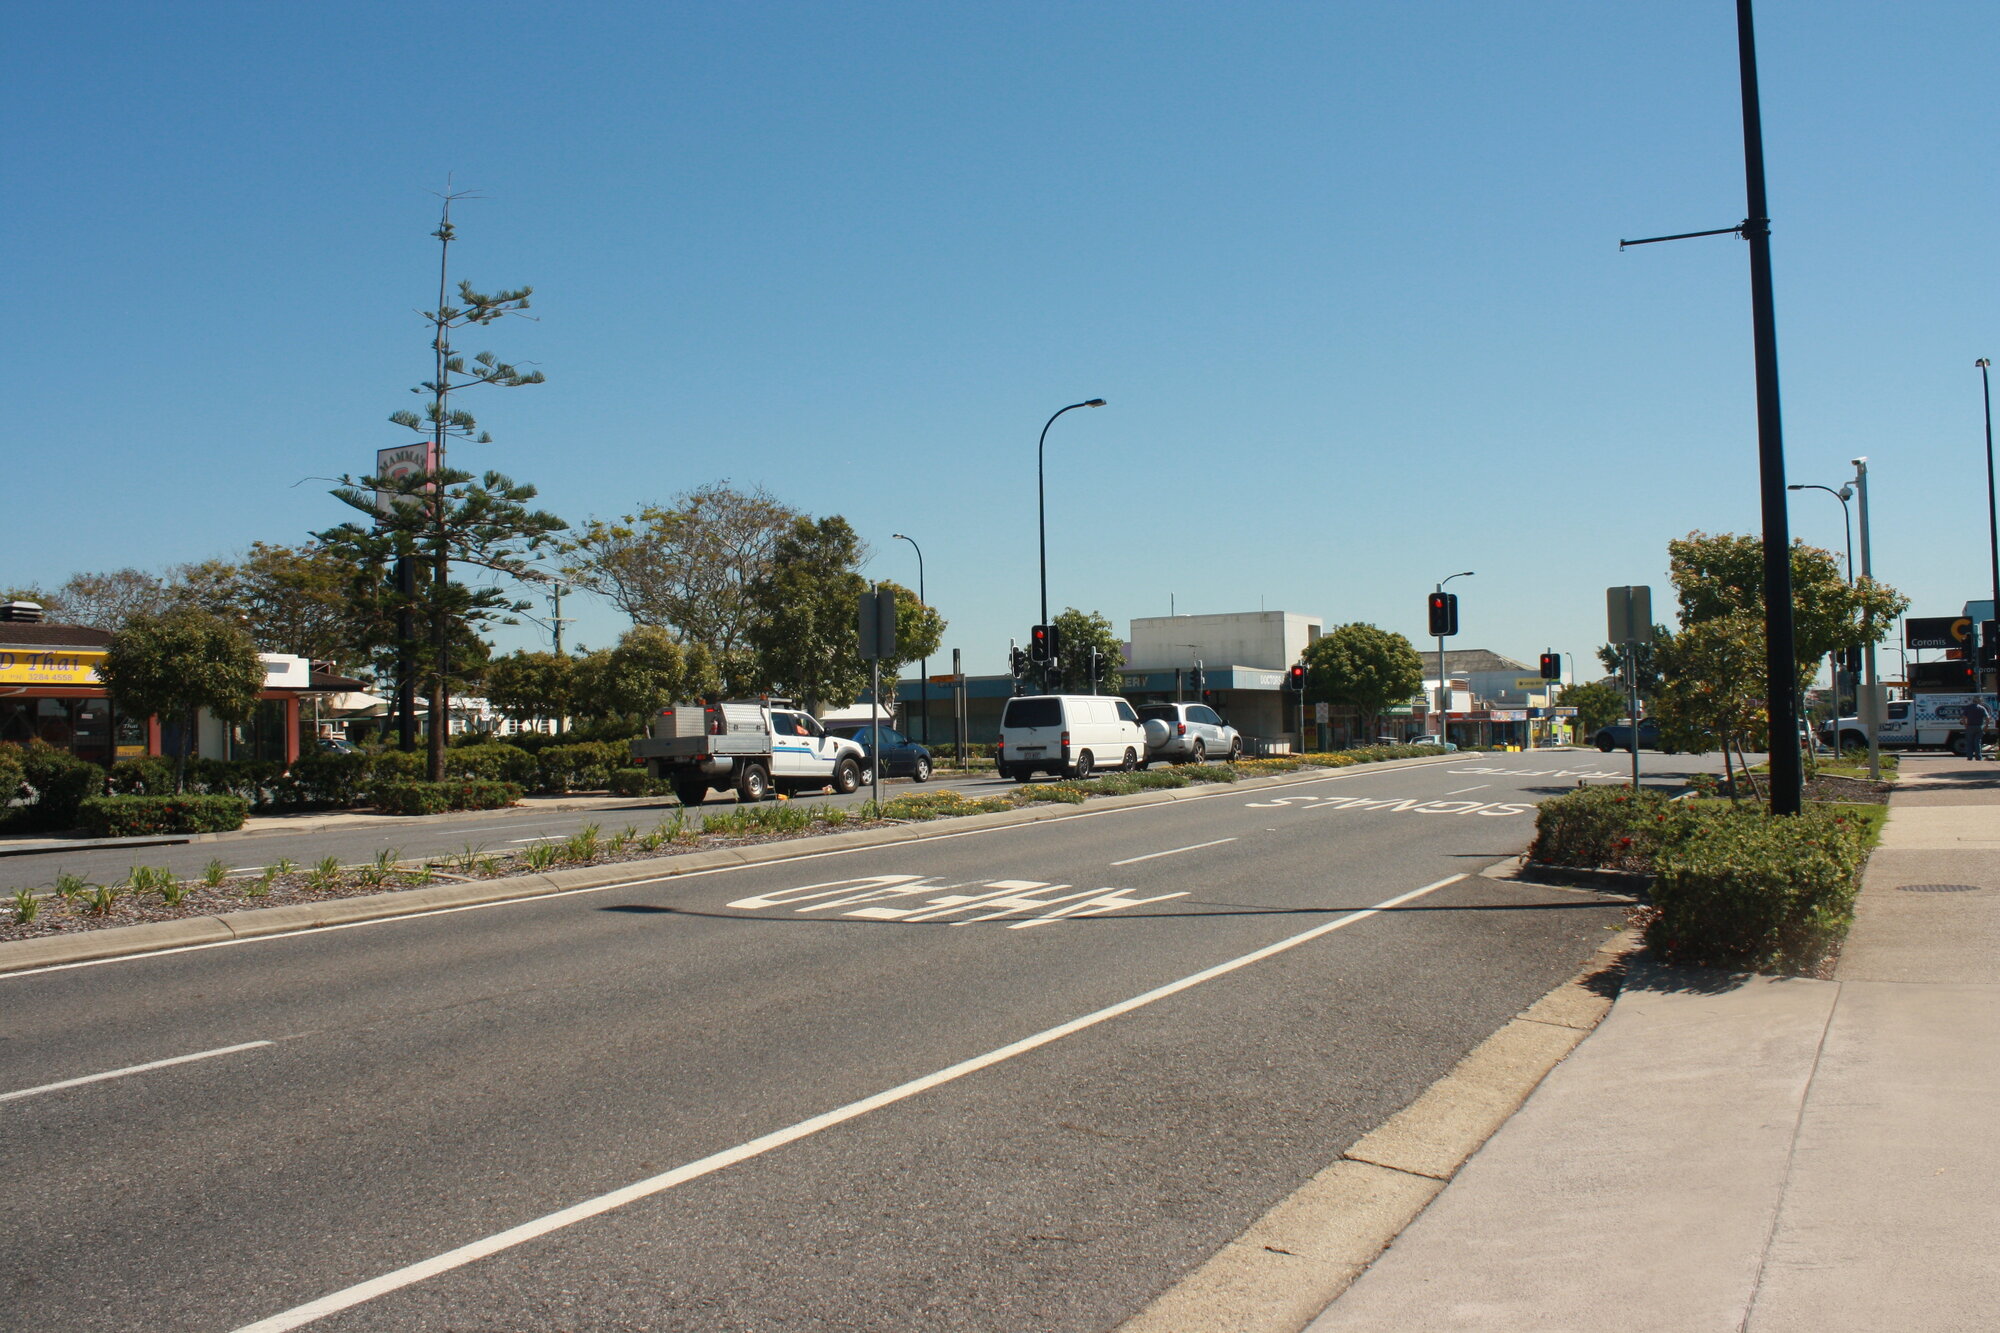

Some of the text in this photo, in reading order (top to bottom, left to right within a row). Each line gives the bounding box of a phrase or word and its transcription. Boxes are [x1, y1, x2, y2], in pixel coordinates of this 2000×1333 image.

[1911, 638, 1947, 647] Coronis
[25, 651, 81, 671] Thai
[1447, 767, 1634, 780] TRAFFIC
[1245, 796, 1537, 816] SIGNALS
[725, 874, 1191, 930] AHEAD
